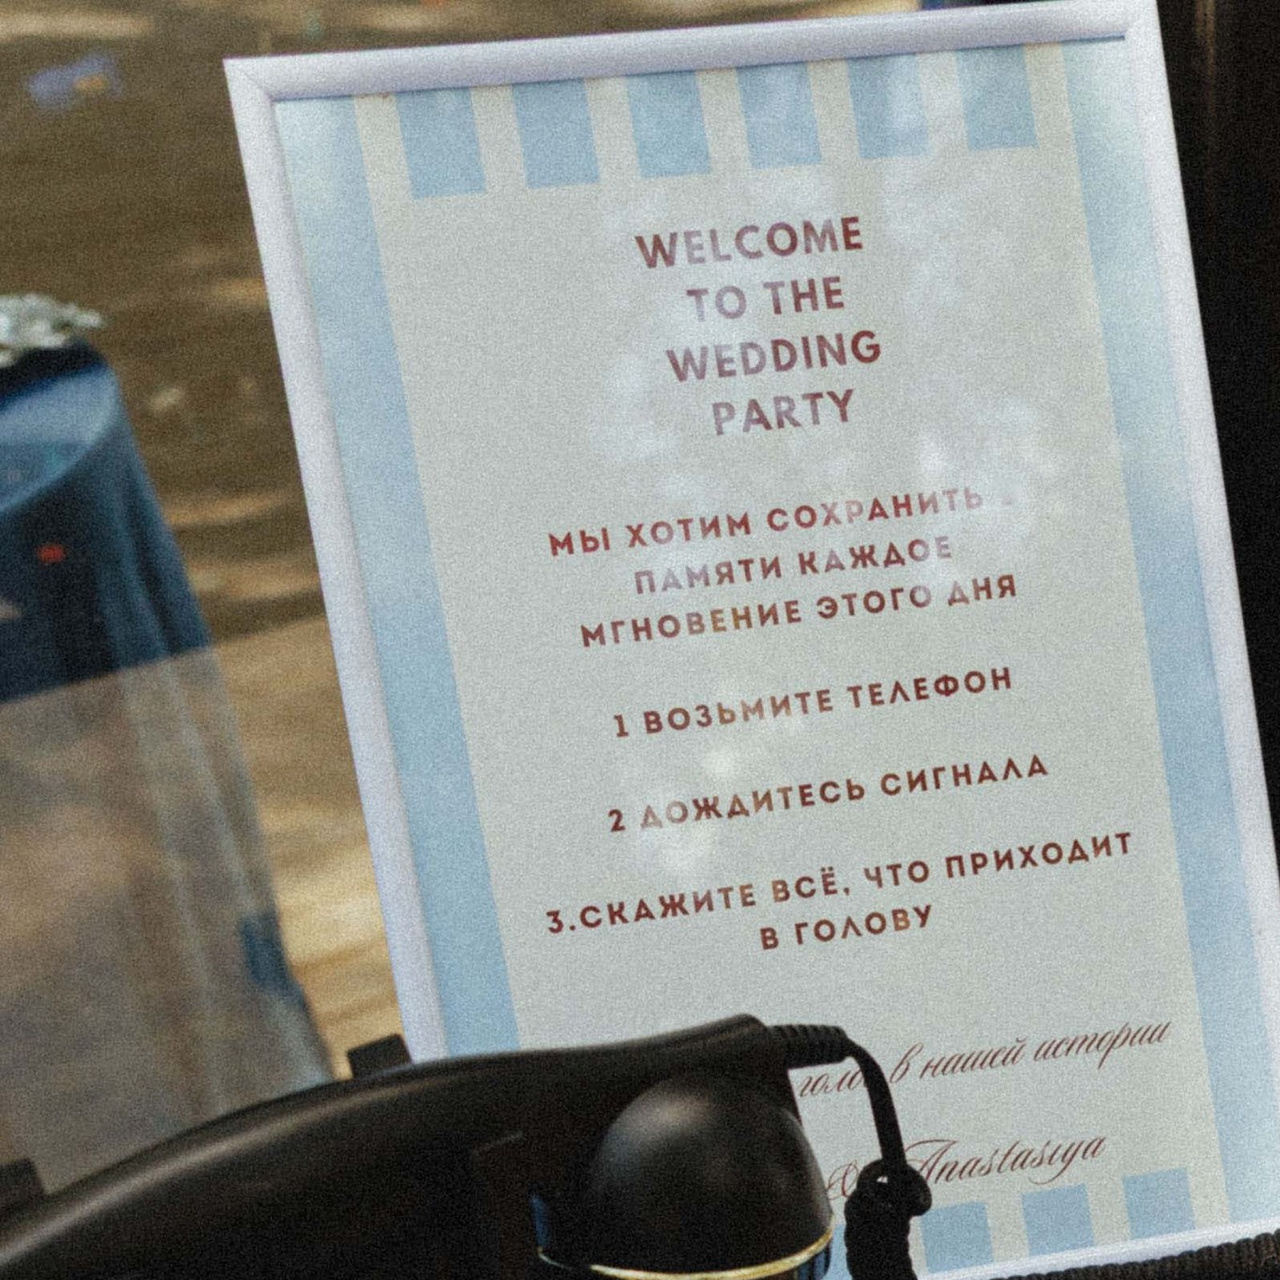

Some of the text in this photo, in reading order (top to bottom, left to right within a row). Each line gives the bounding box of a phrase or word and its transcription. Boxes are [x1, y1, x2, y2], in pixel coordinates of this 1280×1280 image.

[634, 214, 864, 270] WELCOME
[685, 275, 846, 320] TO THE
[665, 329, 882, 383] WEDDING
[712, 388, 855, 437] PARTY
[547, 526, 611, 558] МЫ
[624, 511, 752, 549] ХОТИМ
[765, 487, 983, 533] СОХРАНИТЬ
[634, 536, 952, 595] ПАМЯТИ КАЖДОЕ
[579, 573, 1017, 649] МГНОВЕНИЕ ЭТОГО ДНЯ
[612, 666, 1013, 739] 1 ВОЗЬМИТЕ ТЕЛЕФОН
[607, 753, 1049, 834] 2 ДОЖДИТЕСЬ СИГНАЛА
[771, 865, 851, 904] ВСЁ,
[863, 859, 931, 889] ЧТО
[944, 831, 1133, 880] ПРИХОДИТ
[759, 902, 932, 951] В ГОЛОВУ
[799, 1021, 1171, 1098] голо в нашей истории
